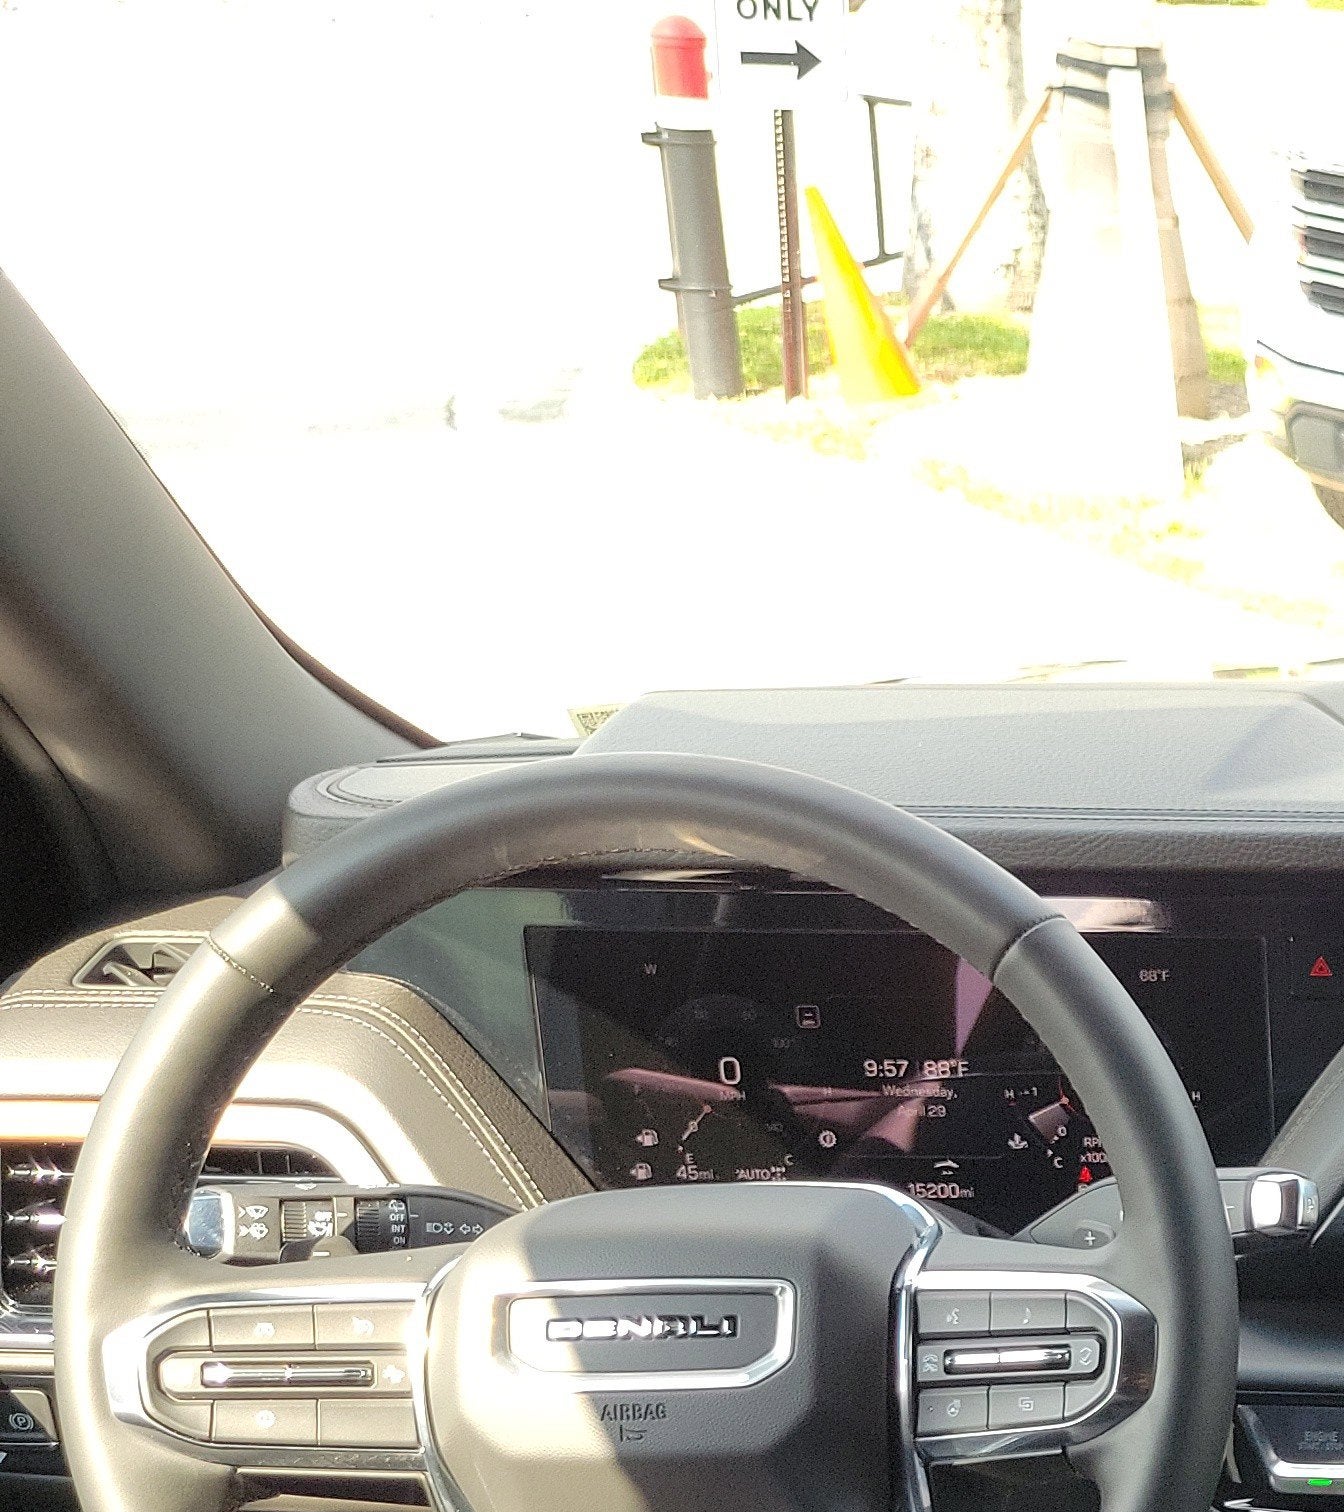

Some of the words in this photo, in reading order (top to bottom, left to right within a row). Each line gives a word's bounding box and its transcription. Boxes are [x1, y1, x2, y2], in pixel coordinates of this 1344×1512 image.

[737, 0, 819, 22] ONLY
[863, 1058, 909, 1078] 9:57
[923, 1058, 970, 1078] 88°F
[1082, 1136, 1102, 1147] RP
[738, 1168, 771, 1180] AUTO
[546, 1315, 739, 1342] DENALI
[600, 1402, 667, 1422] AIRBAG
